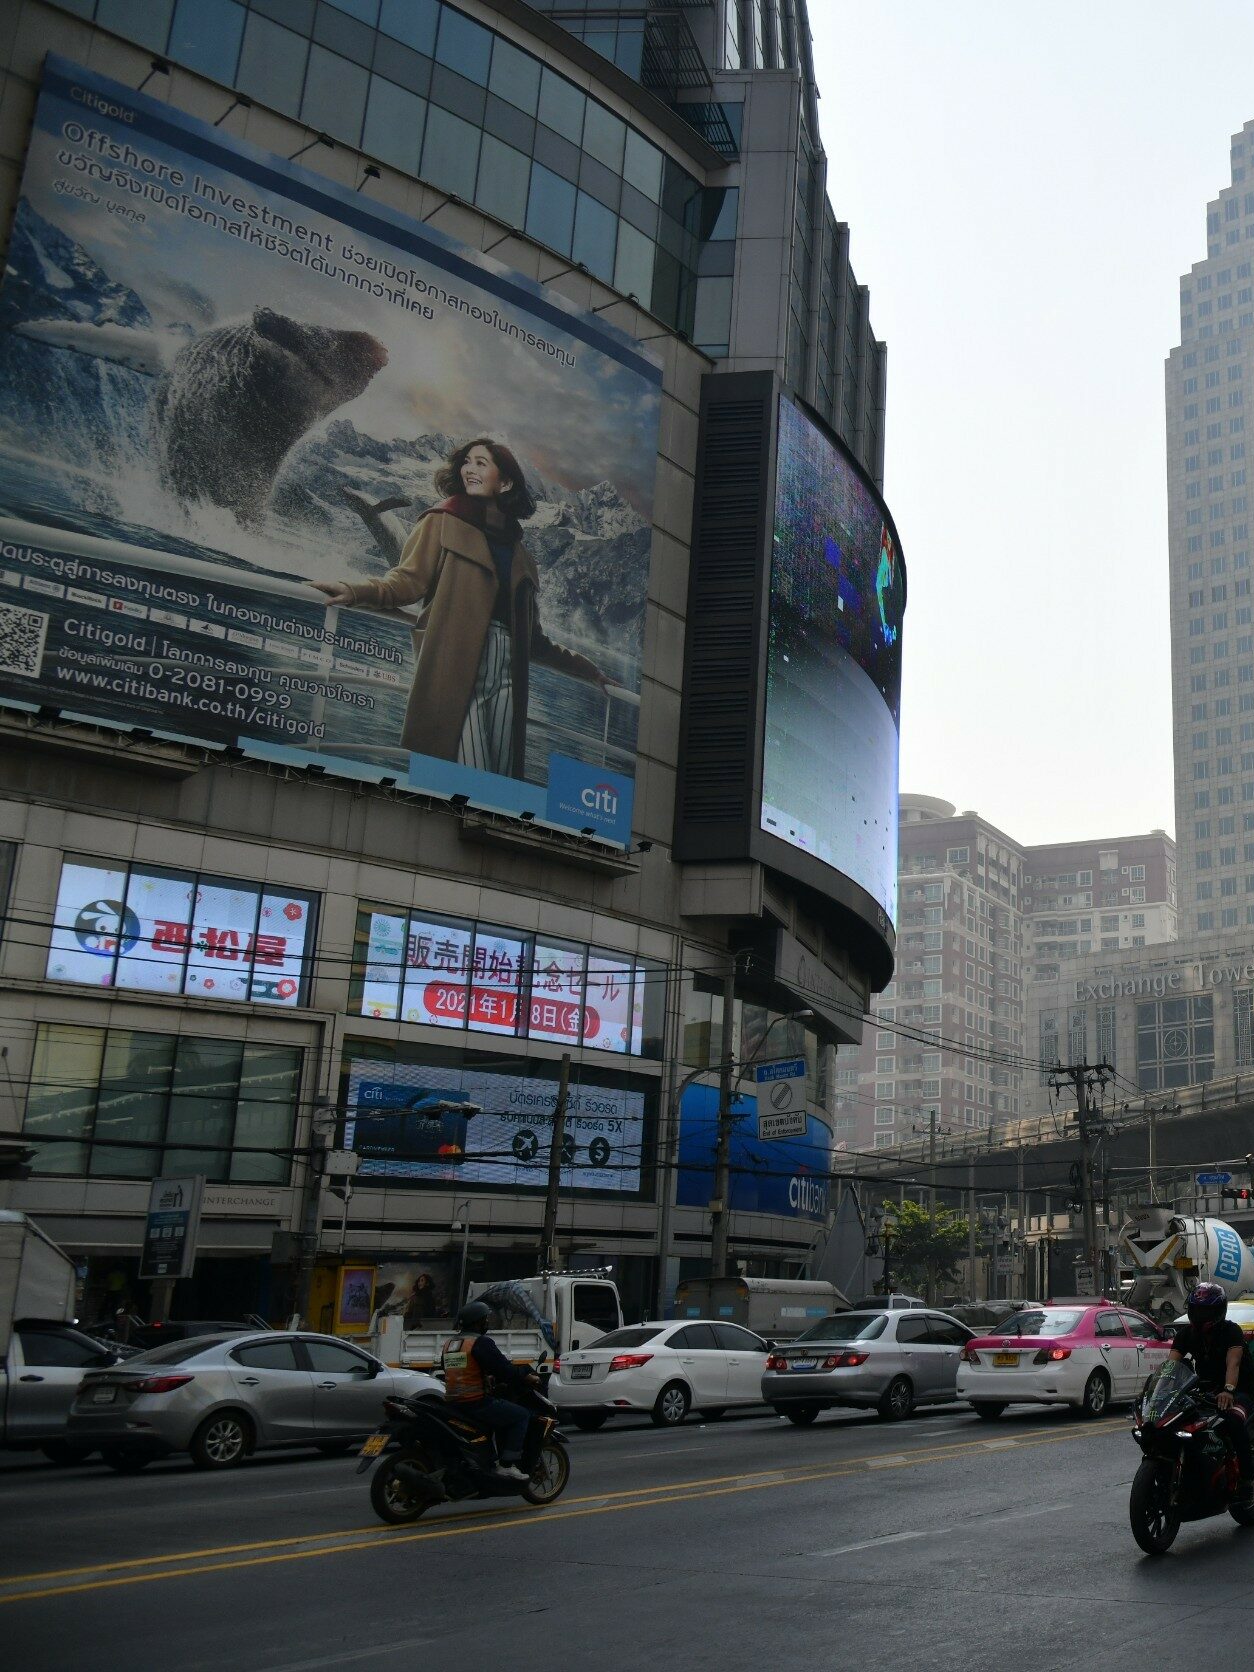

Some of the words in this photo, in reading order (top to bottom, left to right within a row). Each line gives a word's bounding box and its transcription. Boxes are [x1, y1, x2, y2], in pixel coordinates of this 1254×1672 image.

[69, 86, 137, 123] Citigold
[63, 121, 185, 186] Offshore
[192, 175, 335, 252] Investment
[64, 617, 146, 652] Citigold
[57, 666, 326, 739] www.citibank.co.th/citigold
[149, 662, 292, 709] 0-2081-0999
[581, 786, 617, 814] citi
[150, 919, 288, 967] 西松屋
[1073, 969, 1181, 1001] Exchange
[364, 1087, 383, 1100] citi
[203, 1196, 276, 1206] INTERCHANGE
[1218, 1230, 1239, 1277] CPAC
